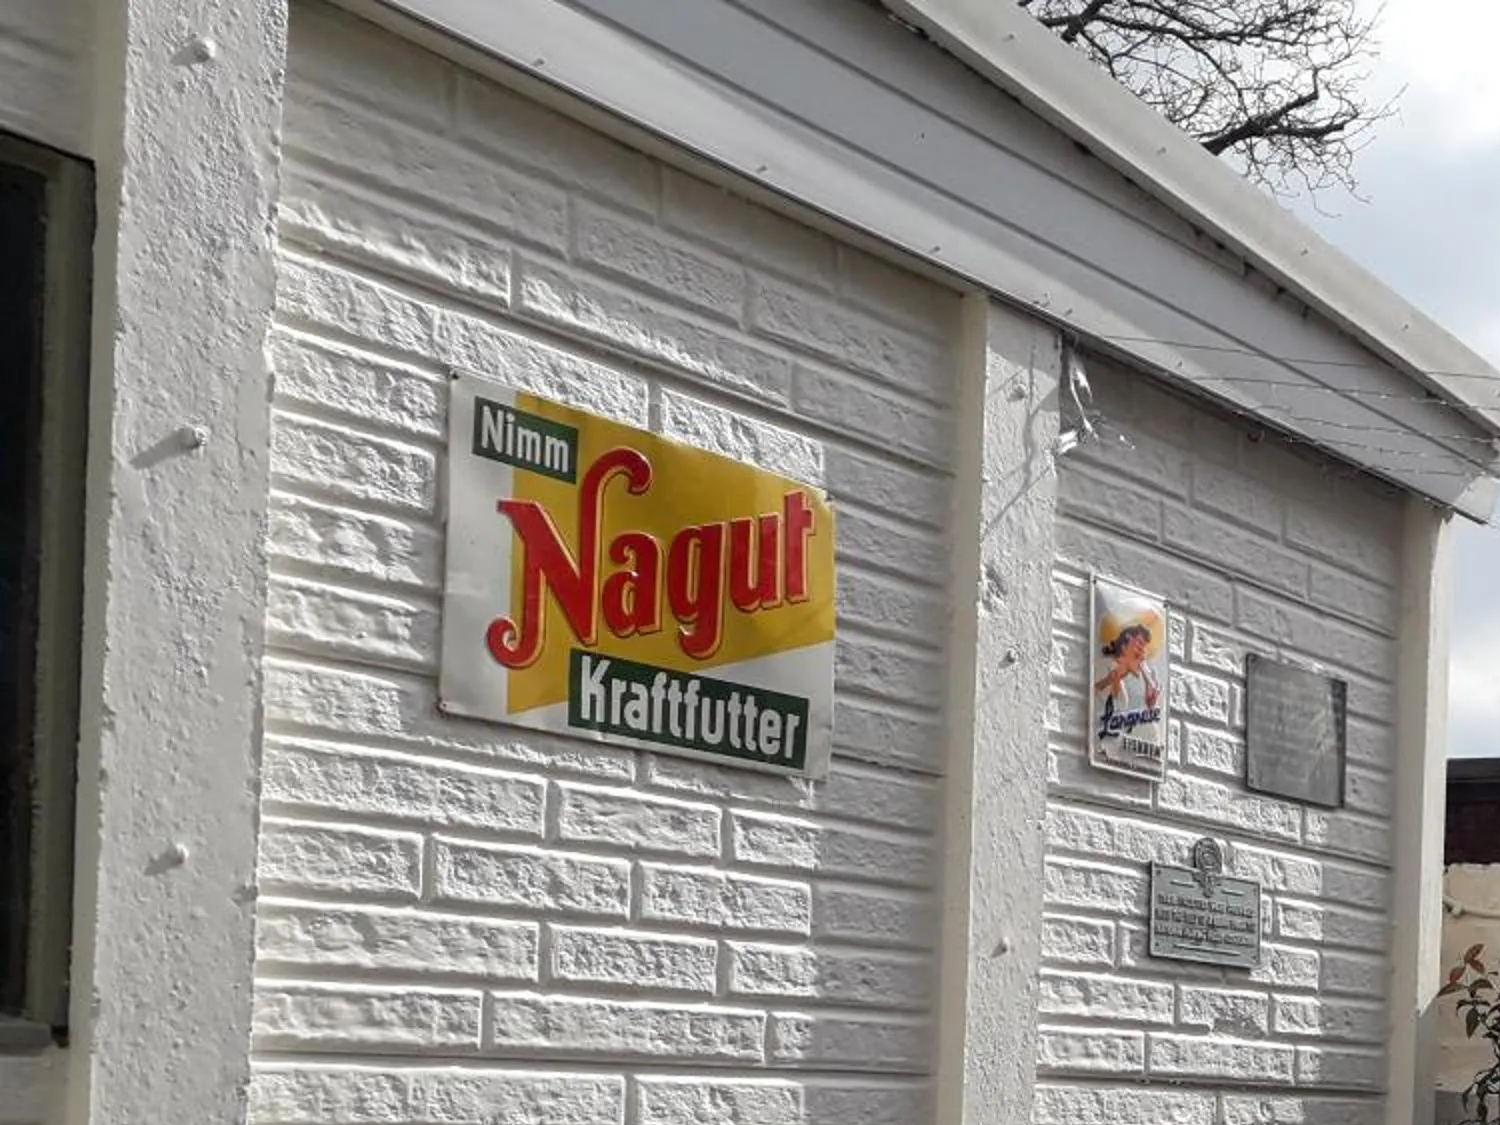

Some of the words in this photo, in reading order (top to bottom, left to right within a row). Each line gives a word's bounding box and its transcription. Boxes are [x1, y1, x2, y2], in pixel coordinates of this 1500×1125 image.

[480, 406, 570, 474] Nimm
[486, 447, 816, 669] Nagut
[579, 654, 801, 760] Kraftfutter
